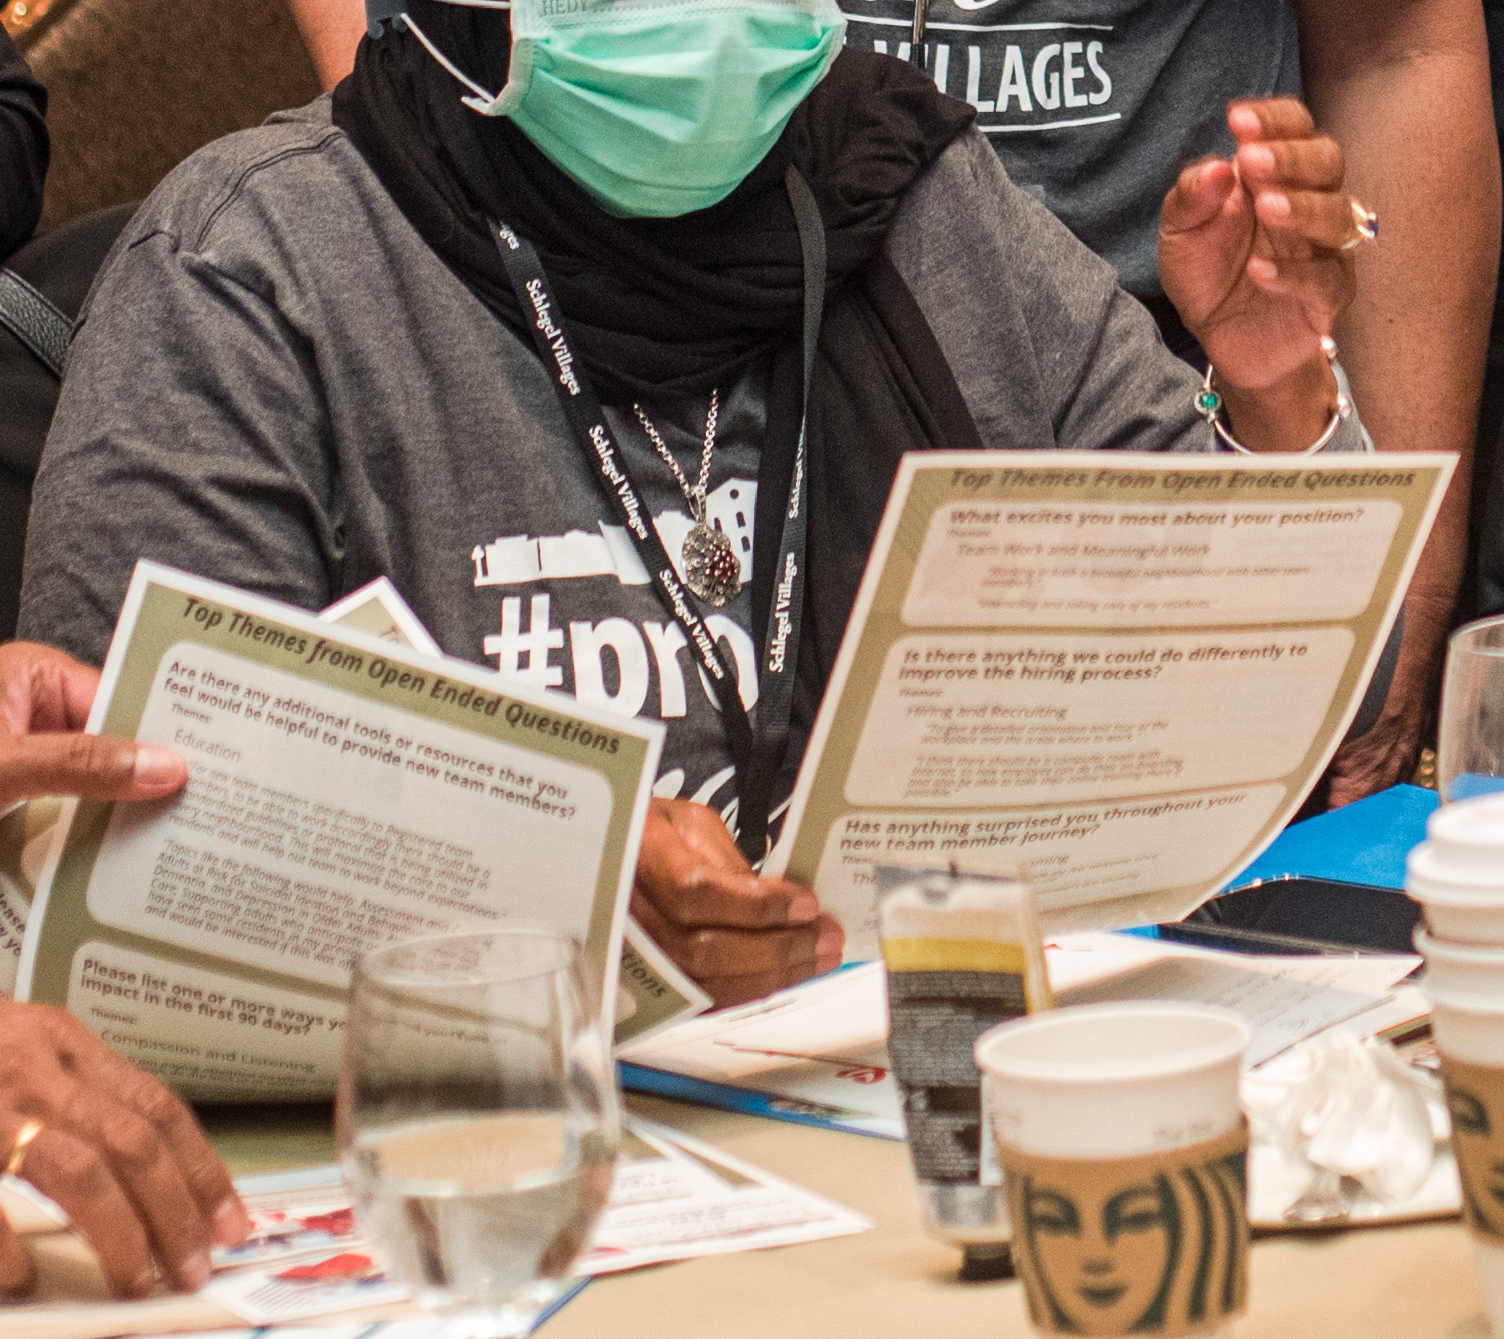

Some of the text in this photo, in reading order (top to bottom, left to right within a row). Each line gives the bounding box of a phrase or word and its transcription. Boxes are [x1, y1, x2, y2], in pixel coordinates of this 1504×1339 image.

[526, 278, 581, 396] Schlegel Villages
[588, 424, 648, 541] Schlegel Villages
[949, 468, 1416, 491] Top Themes From Open Ended Questions
[949, 507, 1365, 528] What excites you most about your position?
[956, 541, 1211, 560] Team Work and Meaningful Work
[659, 567, 724, 680] Schlegel Villages
[769, 551, 798, 673] Schlegel Villages
[182, 596, 620, 755] Top Themes from Open Ended Questions
[897, 663, 1163, 683] improve the hiring process?
[899, 642, 1309, 668] Is there anything we could do differently to
[167, 659, 568, 800] Are there any additional tools or resources that you
[905, 702, 1069, 721] Hiring and Recruiting
[163, 676, 577, 819] feel would be helpful to provide new team members?
[172, 726, 242, 762] Education
[838, 821, 1101, 850] new team member journey?
[844, 792, 1247, 836] Has anything surprised you throughout your
[79, 974, 312, 1036] impact in the first 90 days?
[82, 957, 324, 1028] Please list one or more ways
[99, 1029, 316, 1076] Compassion and Listening
